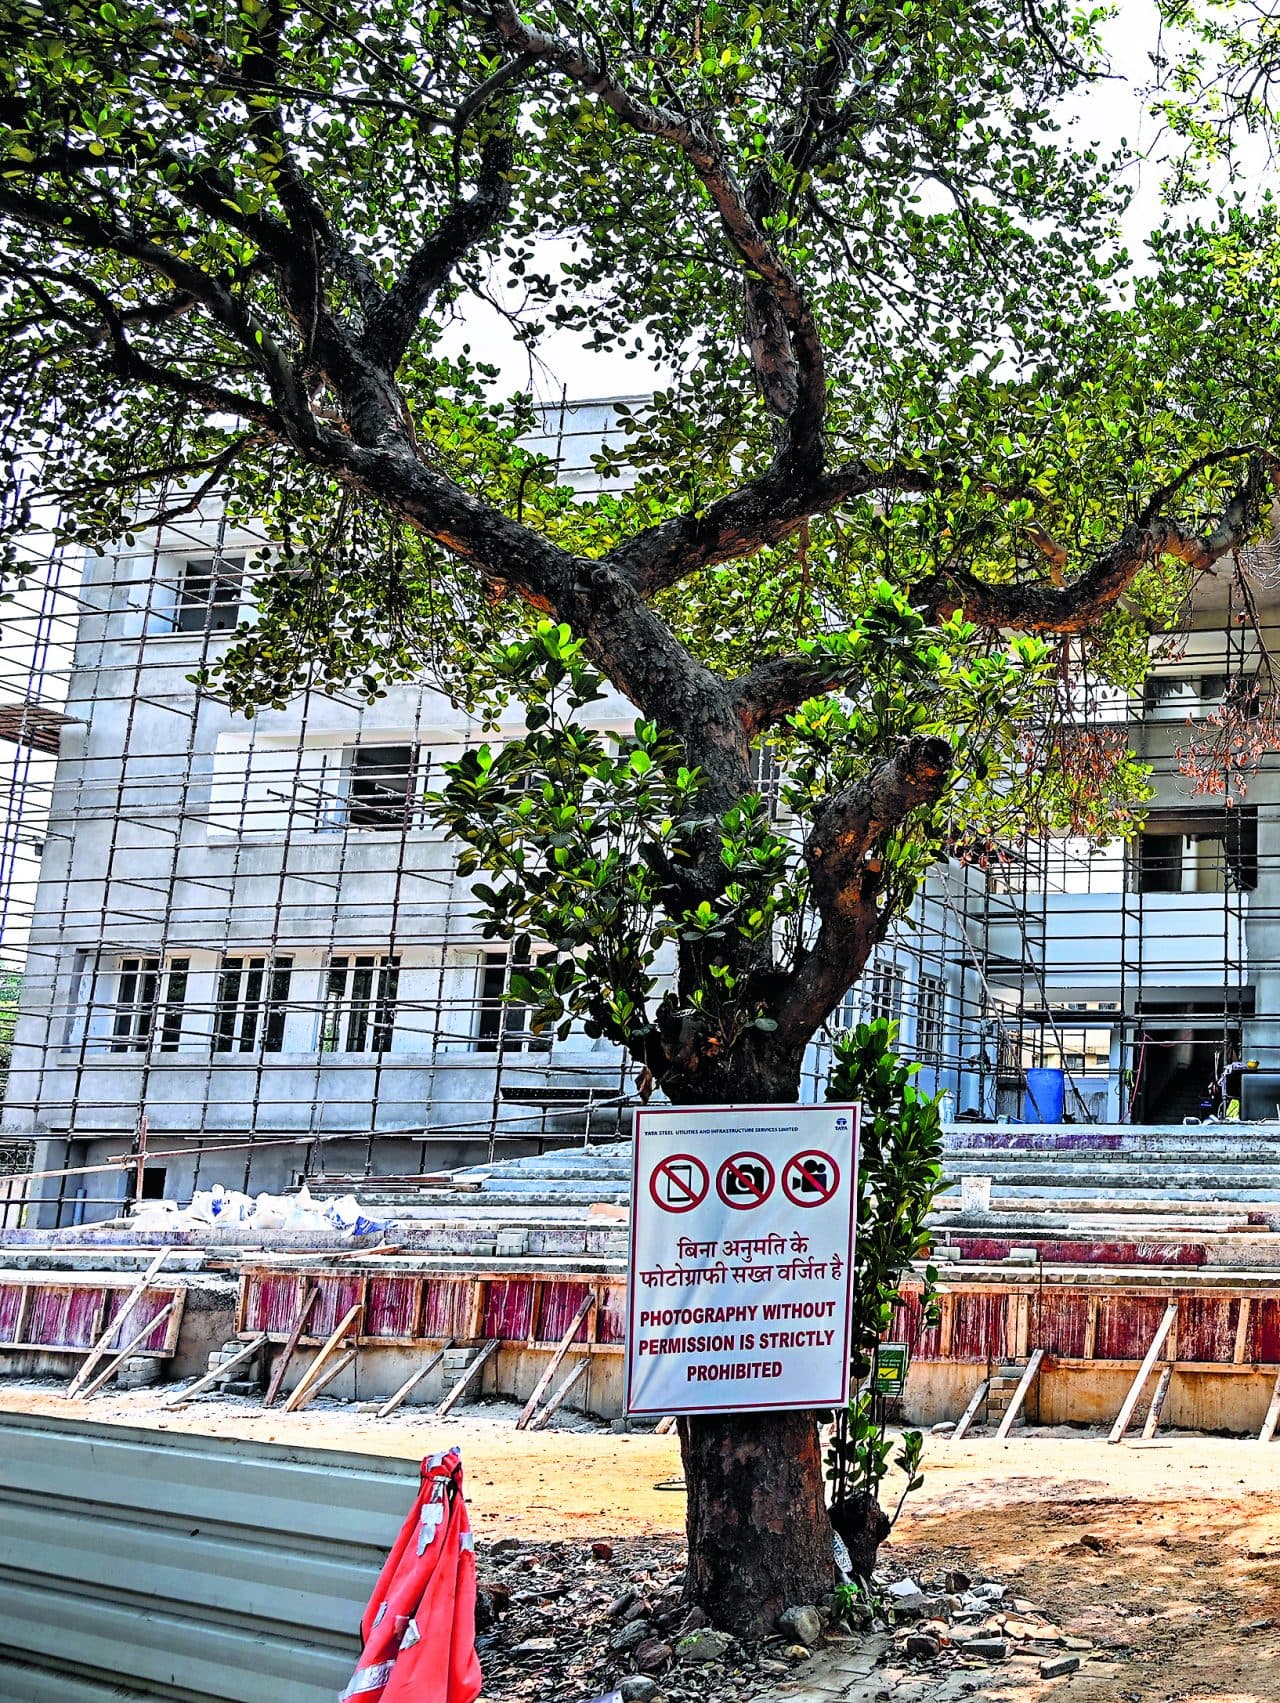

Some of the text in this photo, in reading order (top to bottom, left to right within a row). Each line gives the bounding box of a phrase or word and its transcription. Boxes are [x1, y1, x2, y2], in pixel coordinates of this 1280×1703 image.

[677, 1231, 810, 1263] बिना अनुमति के
[639, 1252, 844, 1288] फोटोग्राफी सख्त वर्जित है
[640, 1301, 836, 1327] PHOTOGRAPHY WITHOUT
[638, 1329, 836, 1356] PERMISSION IS STRICTLY
[687, 1361, 783, 1382] PROHIBITED
